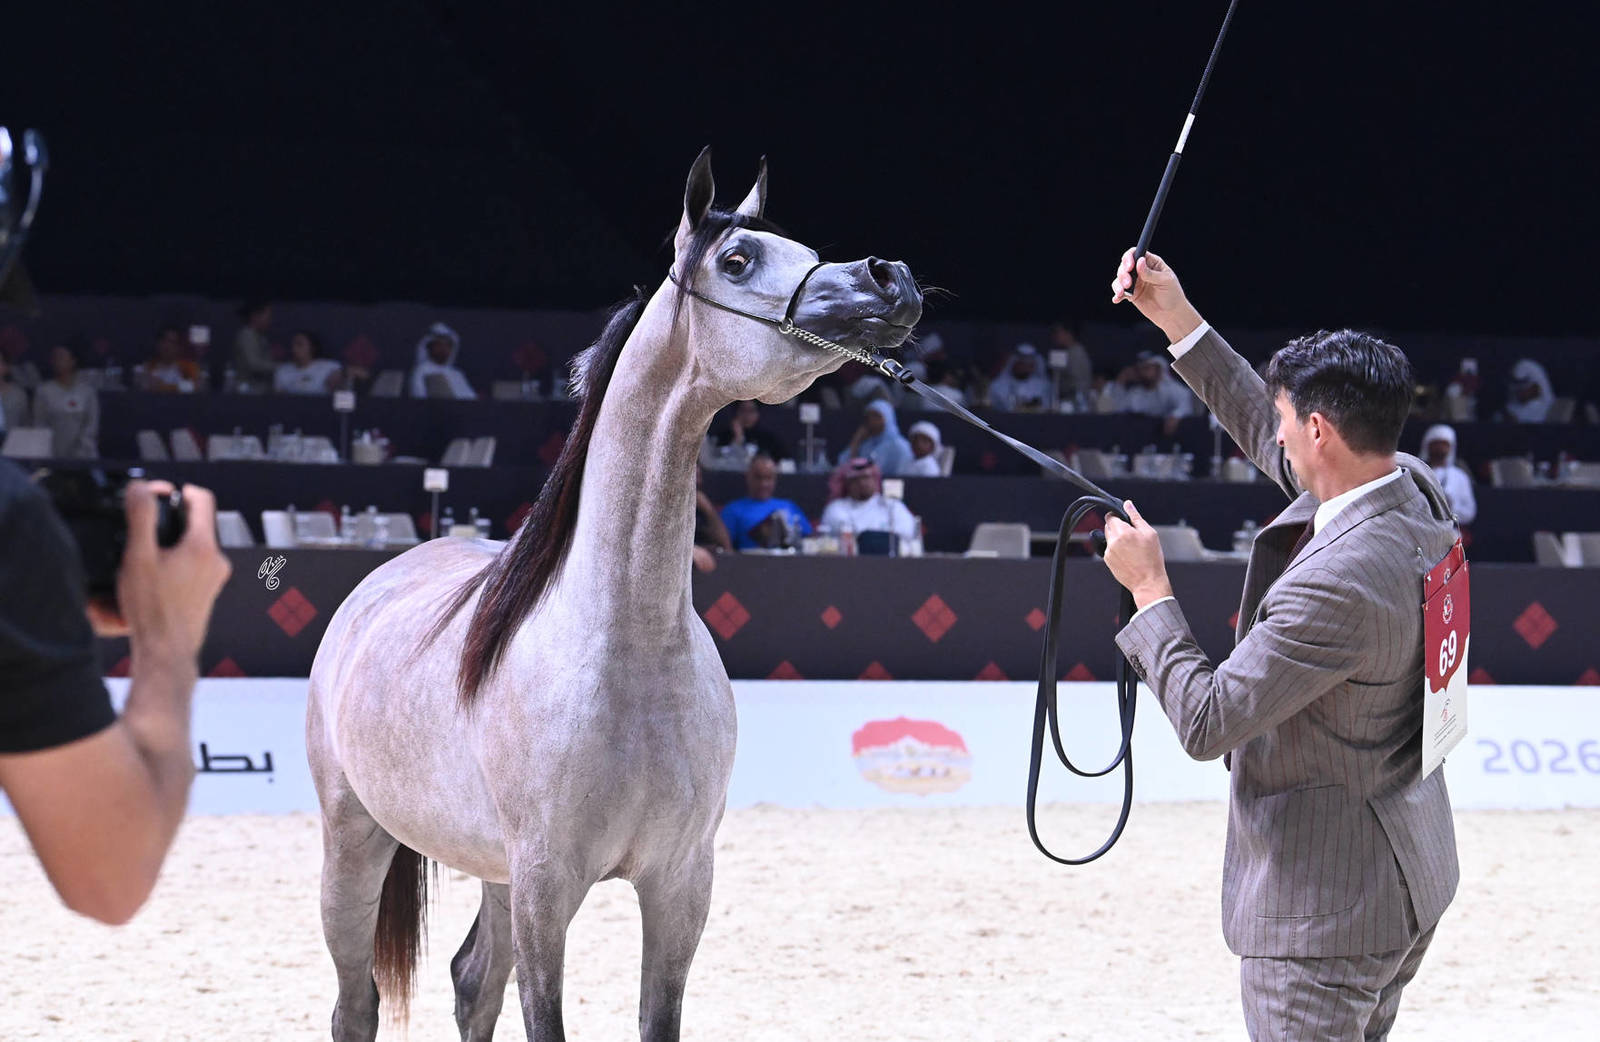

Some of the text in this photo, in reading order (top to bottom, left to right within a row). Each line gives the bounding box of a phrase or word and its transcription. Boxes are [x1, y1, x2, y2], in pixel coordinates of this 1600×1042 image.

[1439, 629, 1457, 677] 69
[197, 741, 274, 784] بط
[1476, 738, 1600, 774] 2026
